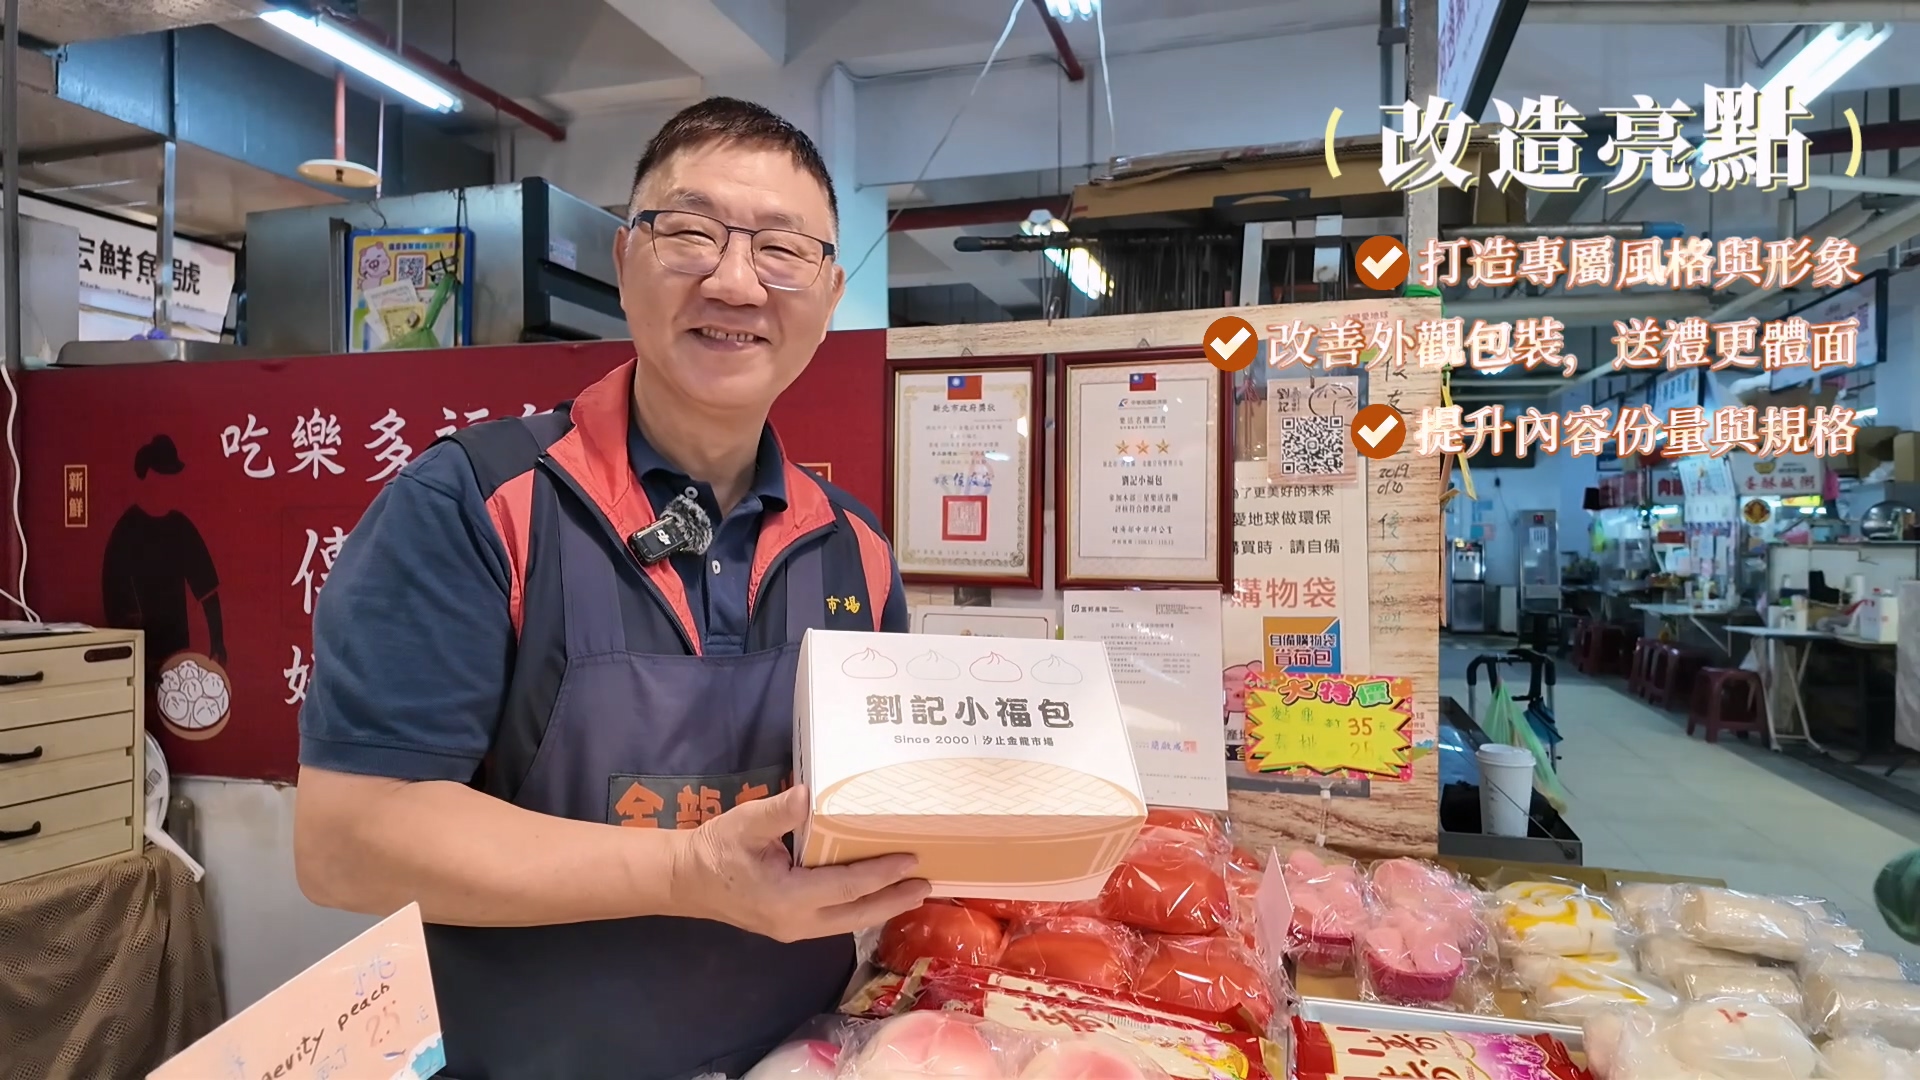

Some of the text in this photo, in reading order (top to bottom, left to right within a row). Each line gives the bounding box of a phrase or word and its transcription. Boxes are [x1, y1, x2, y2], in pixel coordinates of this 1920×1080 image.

[825, 595, 861, 616] 市場
[1269, 634, 1337, 648] 自備購物袋
[1275, 649, 1331, 666] 省荷包
[1280, 680, 1393, 707] 大特價
[866, 694, 1074, 729] 劉記小福包
[1348, 717, 1373, 735] 35
[894, 735, 1055, 747] Since 2000 汐止金龍市場
[337, 983, 391, 1032] peach
